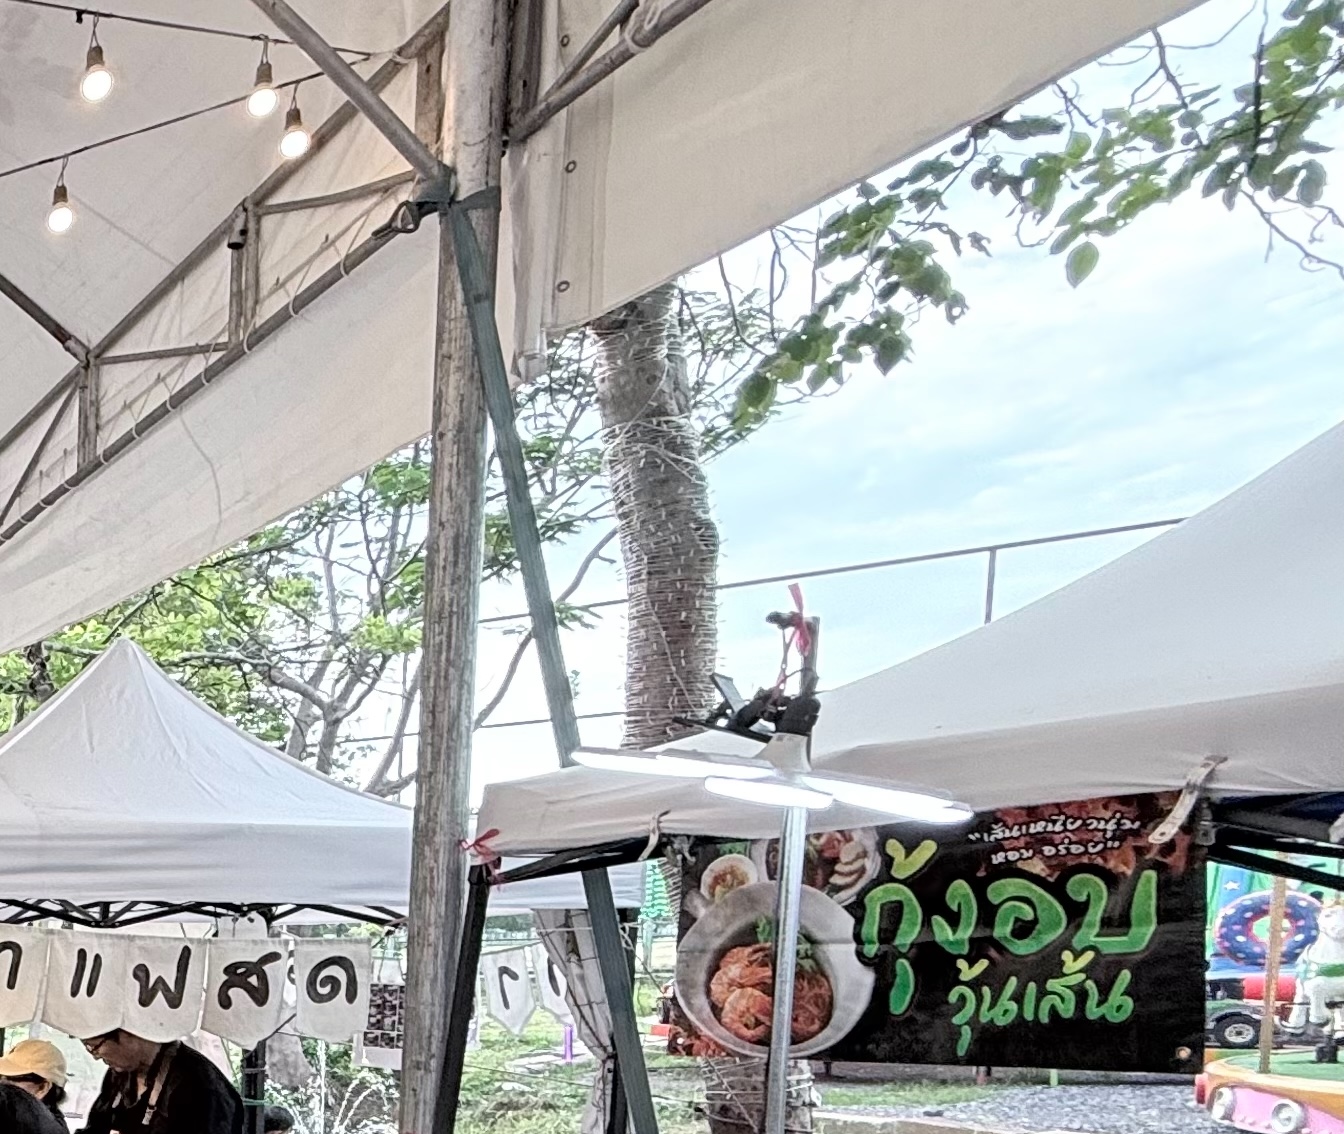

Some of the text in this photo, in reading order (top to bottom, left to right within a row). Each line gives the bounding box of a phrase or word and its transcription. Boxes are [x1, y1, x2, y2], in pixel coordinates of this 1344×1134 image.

[991, 848, 1034, 864] หอม
[862, 838, 1158, 1015] กุ้งอบ
[949, 950, 1134, 1056] วุ้นเส้น
